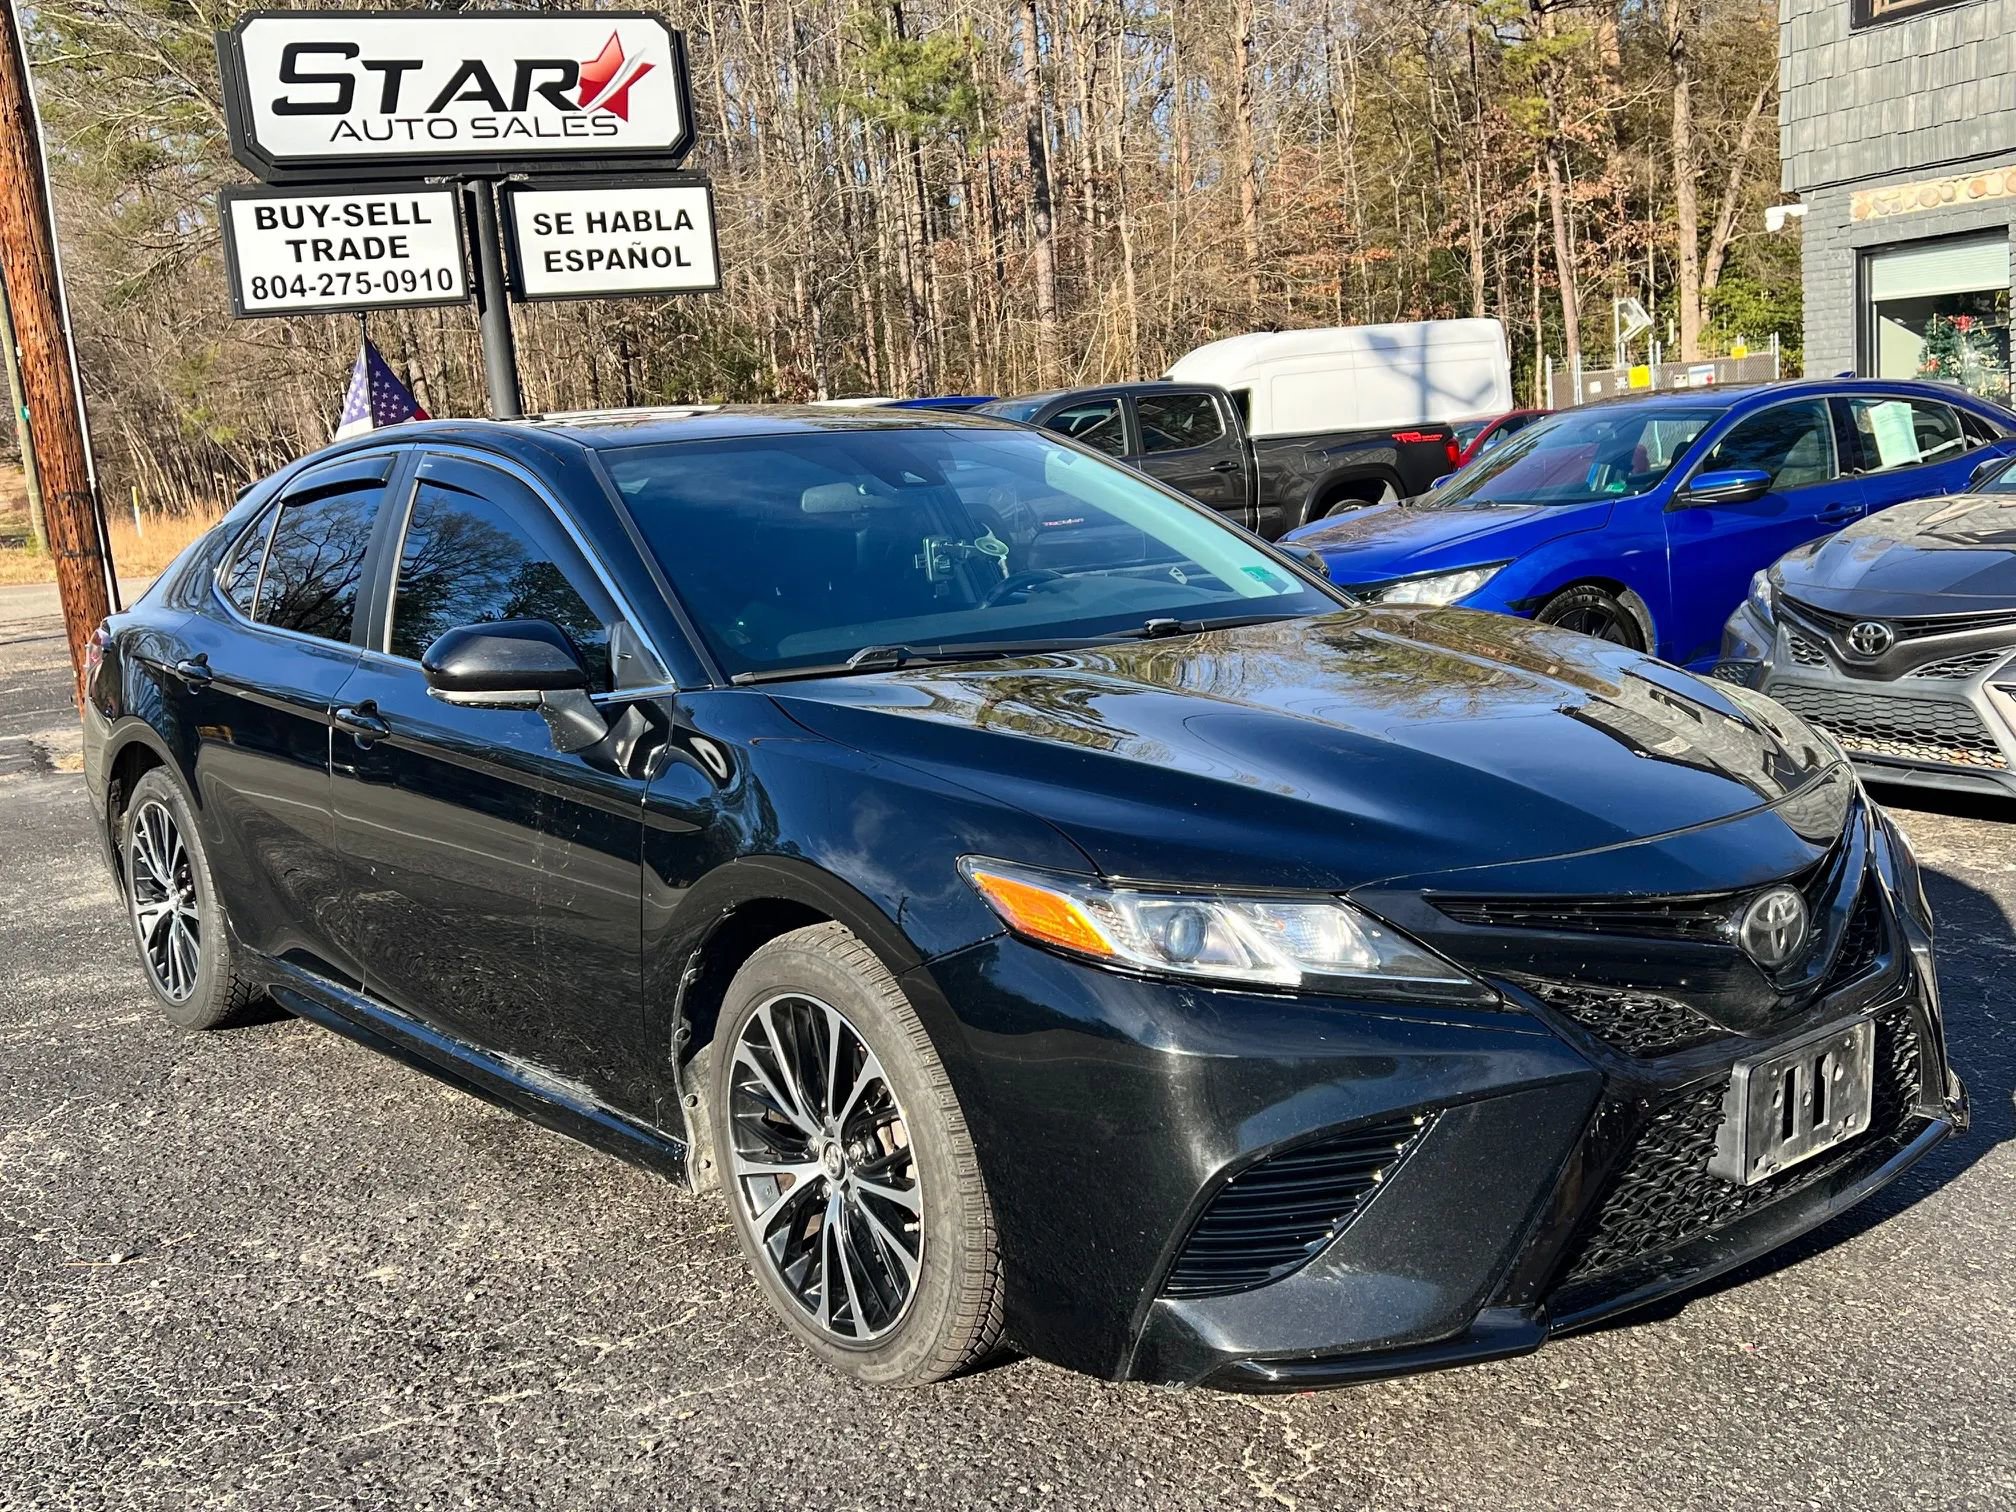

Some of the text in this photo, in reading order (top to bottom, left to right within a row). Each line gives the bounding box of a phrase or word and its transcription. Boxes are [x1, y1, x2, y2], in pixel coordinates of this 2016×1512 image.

[330, 115, 619, 142] AUTO SALES
[254, 201, 432, 231] BUY-SELL
[533, 208, 694, 236] SE HABLA
[285, 235, 410, 263] TRADE
[543, 240, 692, 273] ESPAÑOL
[250, 267, 454, 301] 804-275-0910
